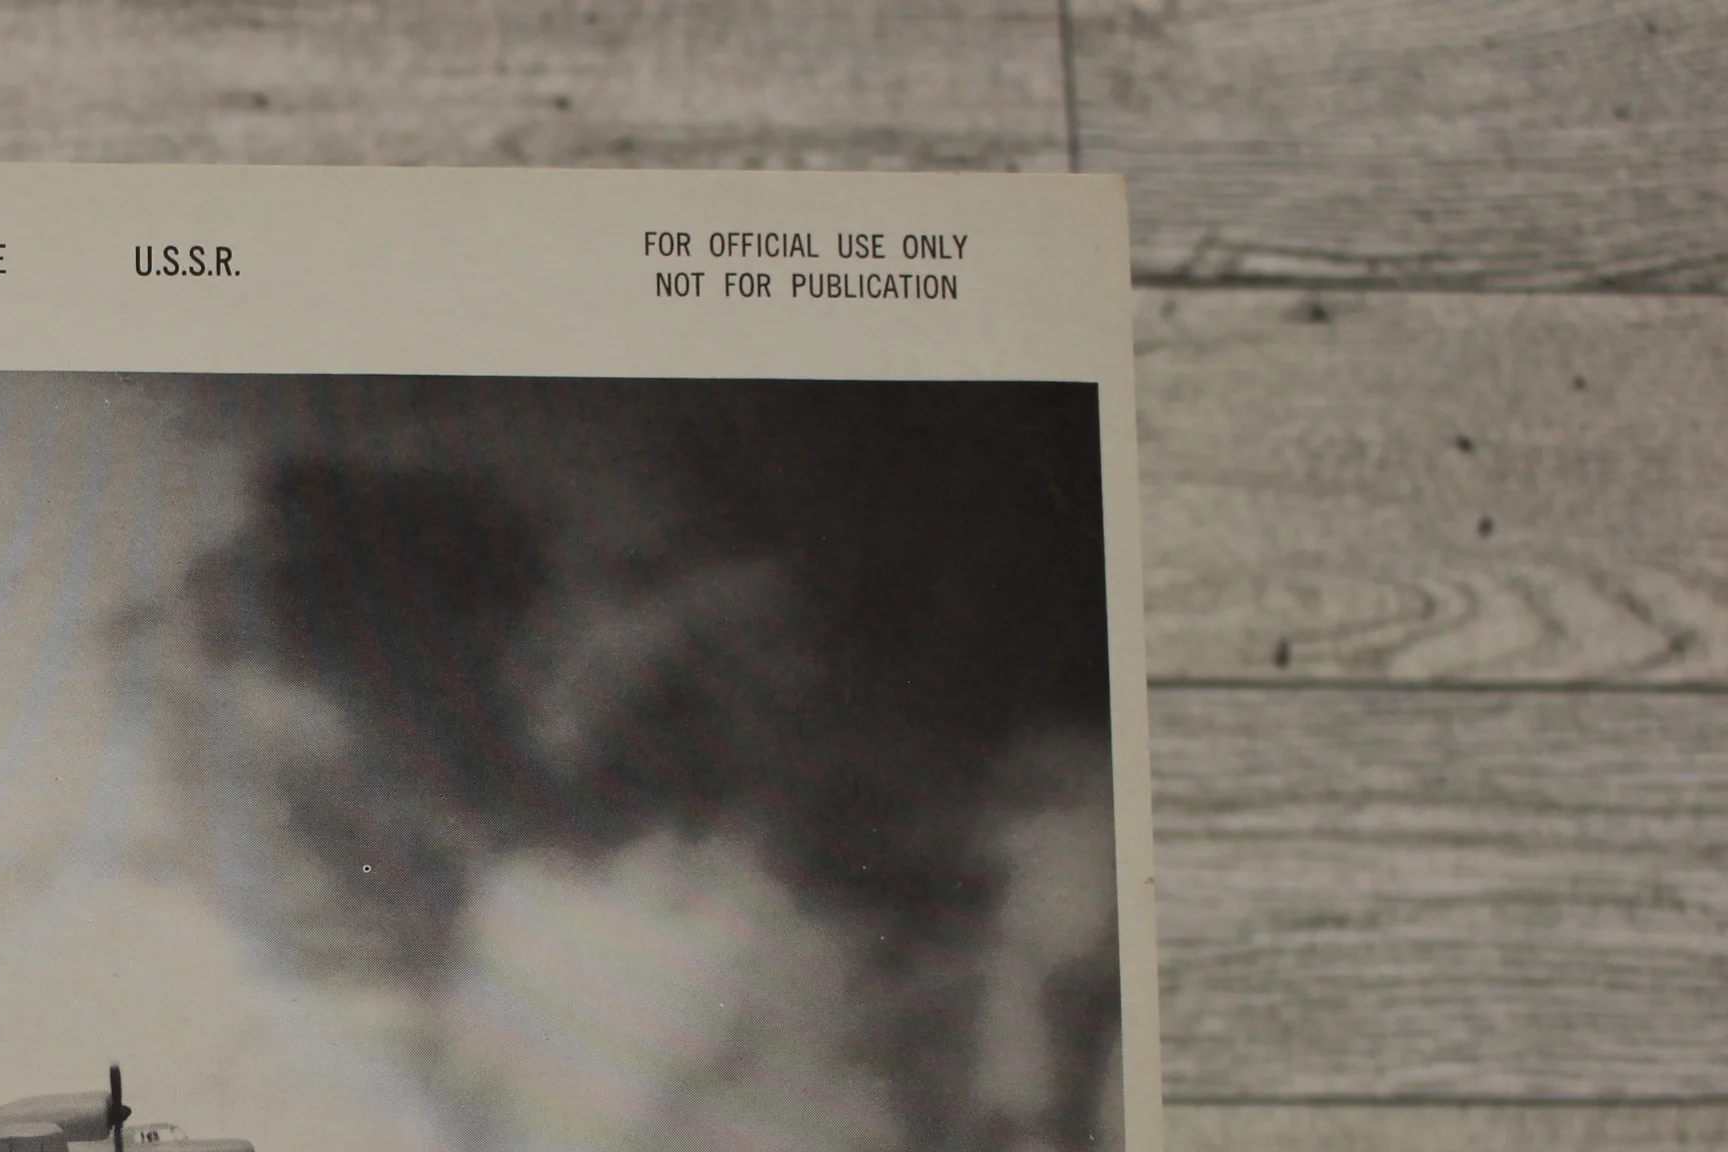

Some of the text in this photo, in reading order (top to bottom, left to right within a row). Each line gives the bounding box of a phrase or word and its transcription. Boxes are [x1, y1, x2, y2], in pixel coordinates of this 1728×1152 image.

[644, 231, 969, 260] FOR OFFICIAL USE ONLY
[134, 244, 241, 277] U.S.S.R.
[655, 271, 958, 300] NOT FOR PUBLICATION
